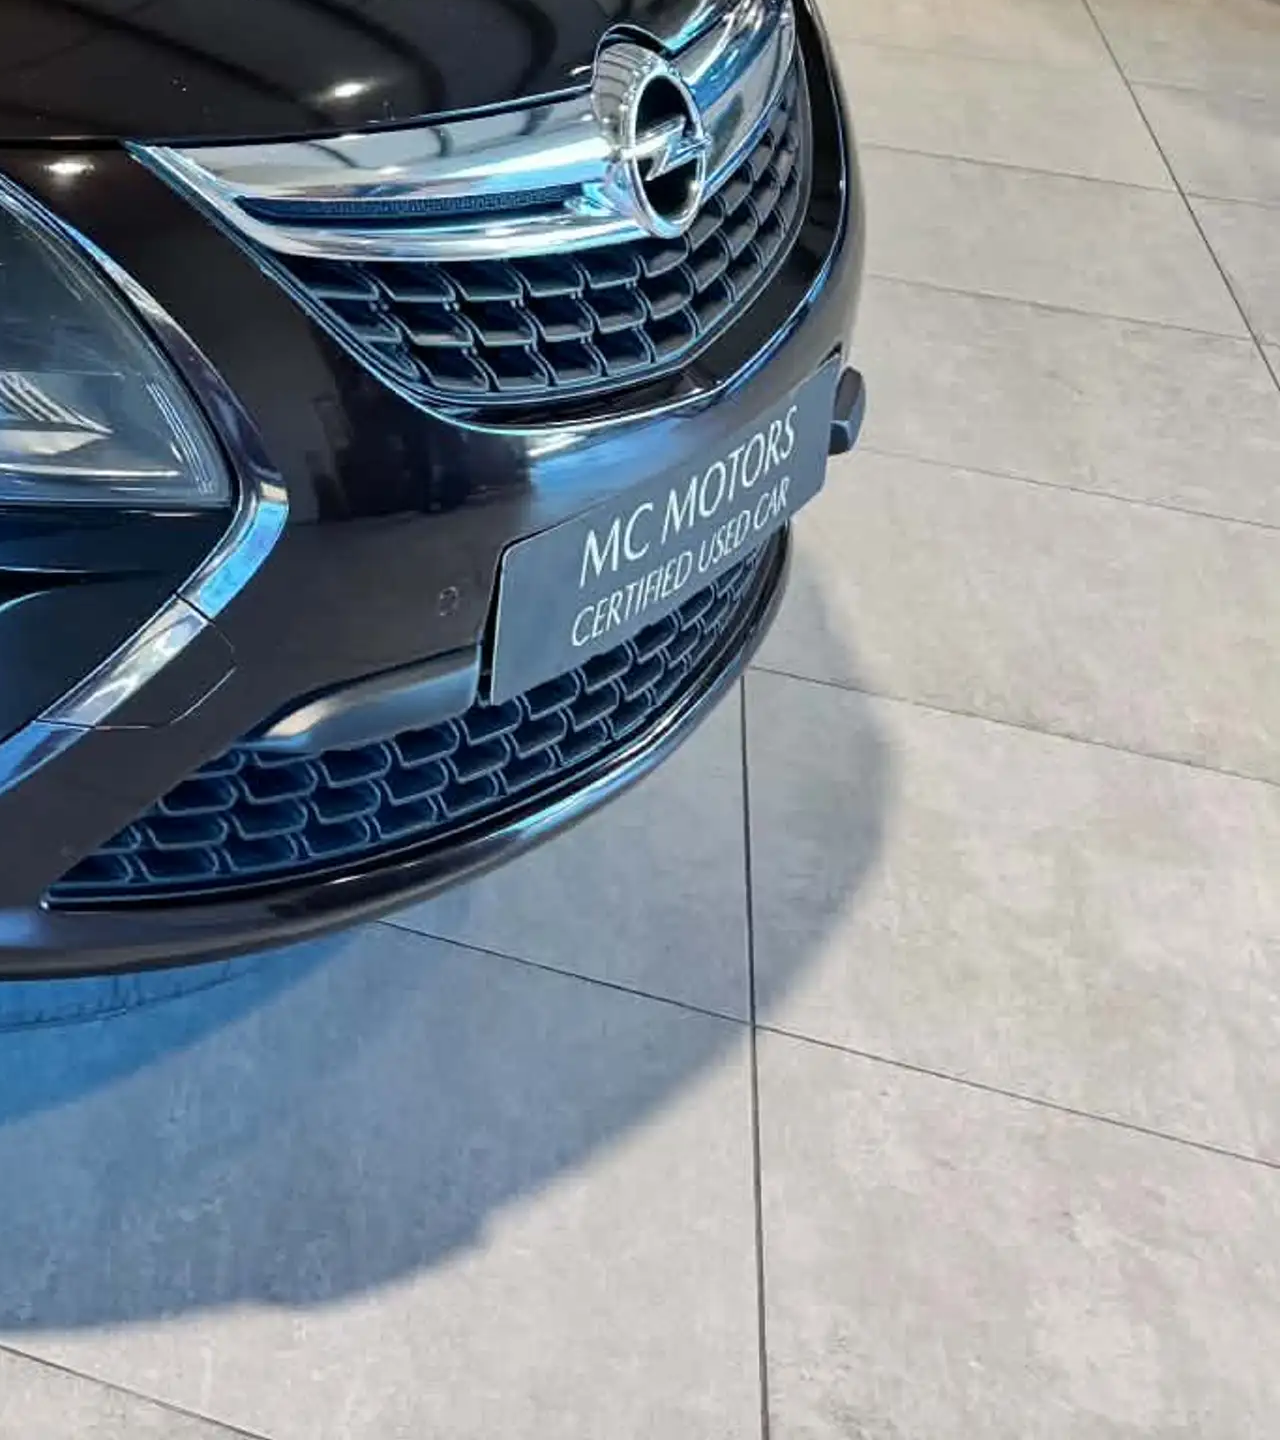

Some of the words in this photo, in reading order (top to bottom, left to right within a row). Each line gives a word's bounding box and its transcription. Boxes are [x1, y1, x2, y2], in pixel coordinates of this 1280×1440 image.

[571, 551, 693, 647] CERTIFIED
[697, 510, 751, 573] USED
[753, 476, 790, 531] CAR
[579, 502, 654, 588] MC
[661, 405, 798, 545] MOTORS
